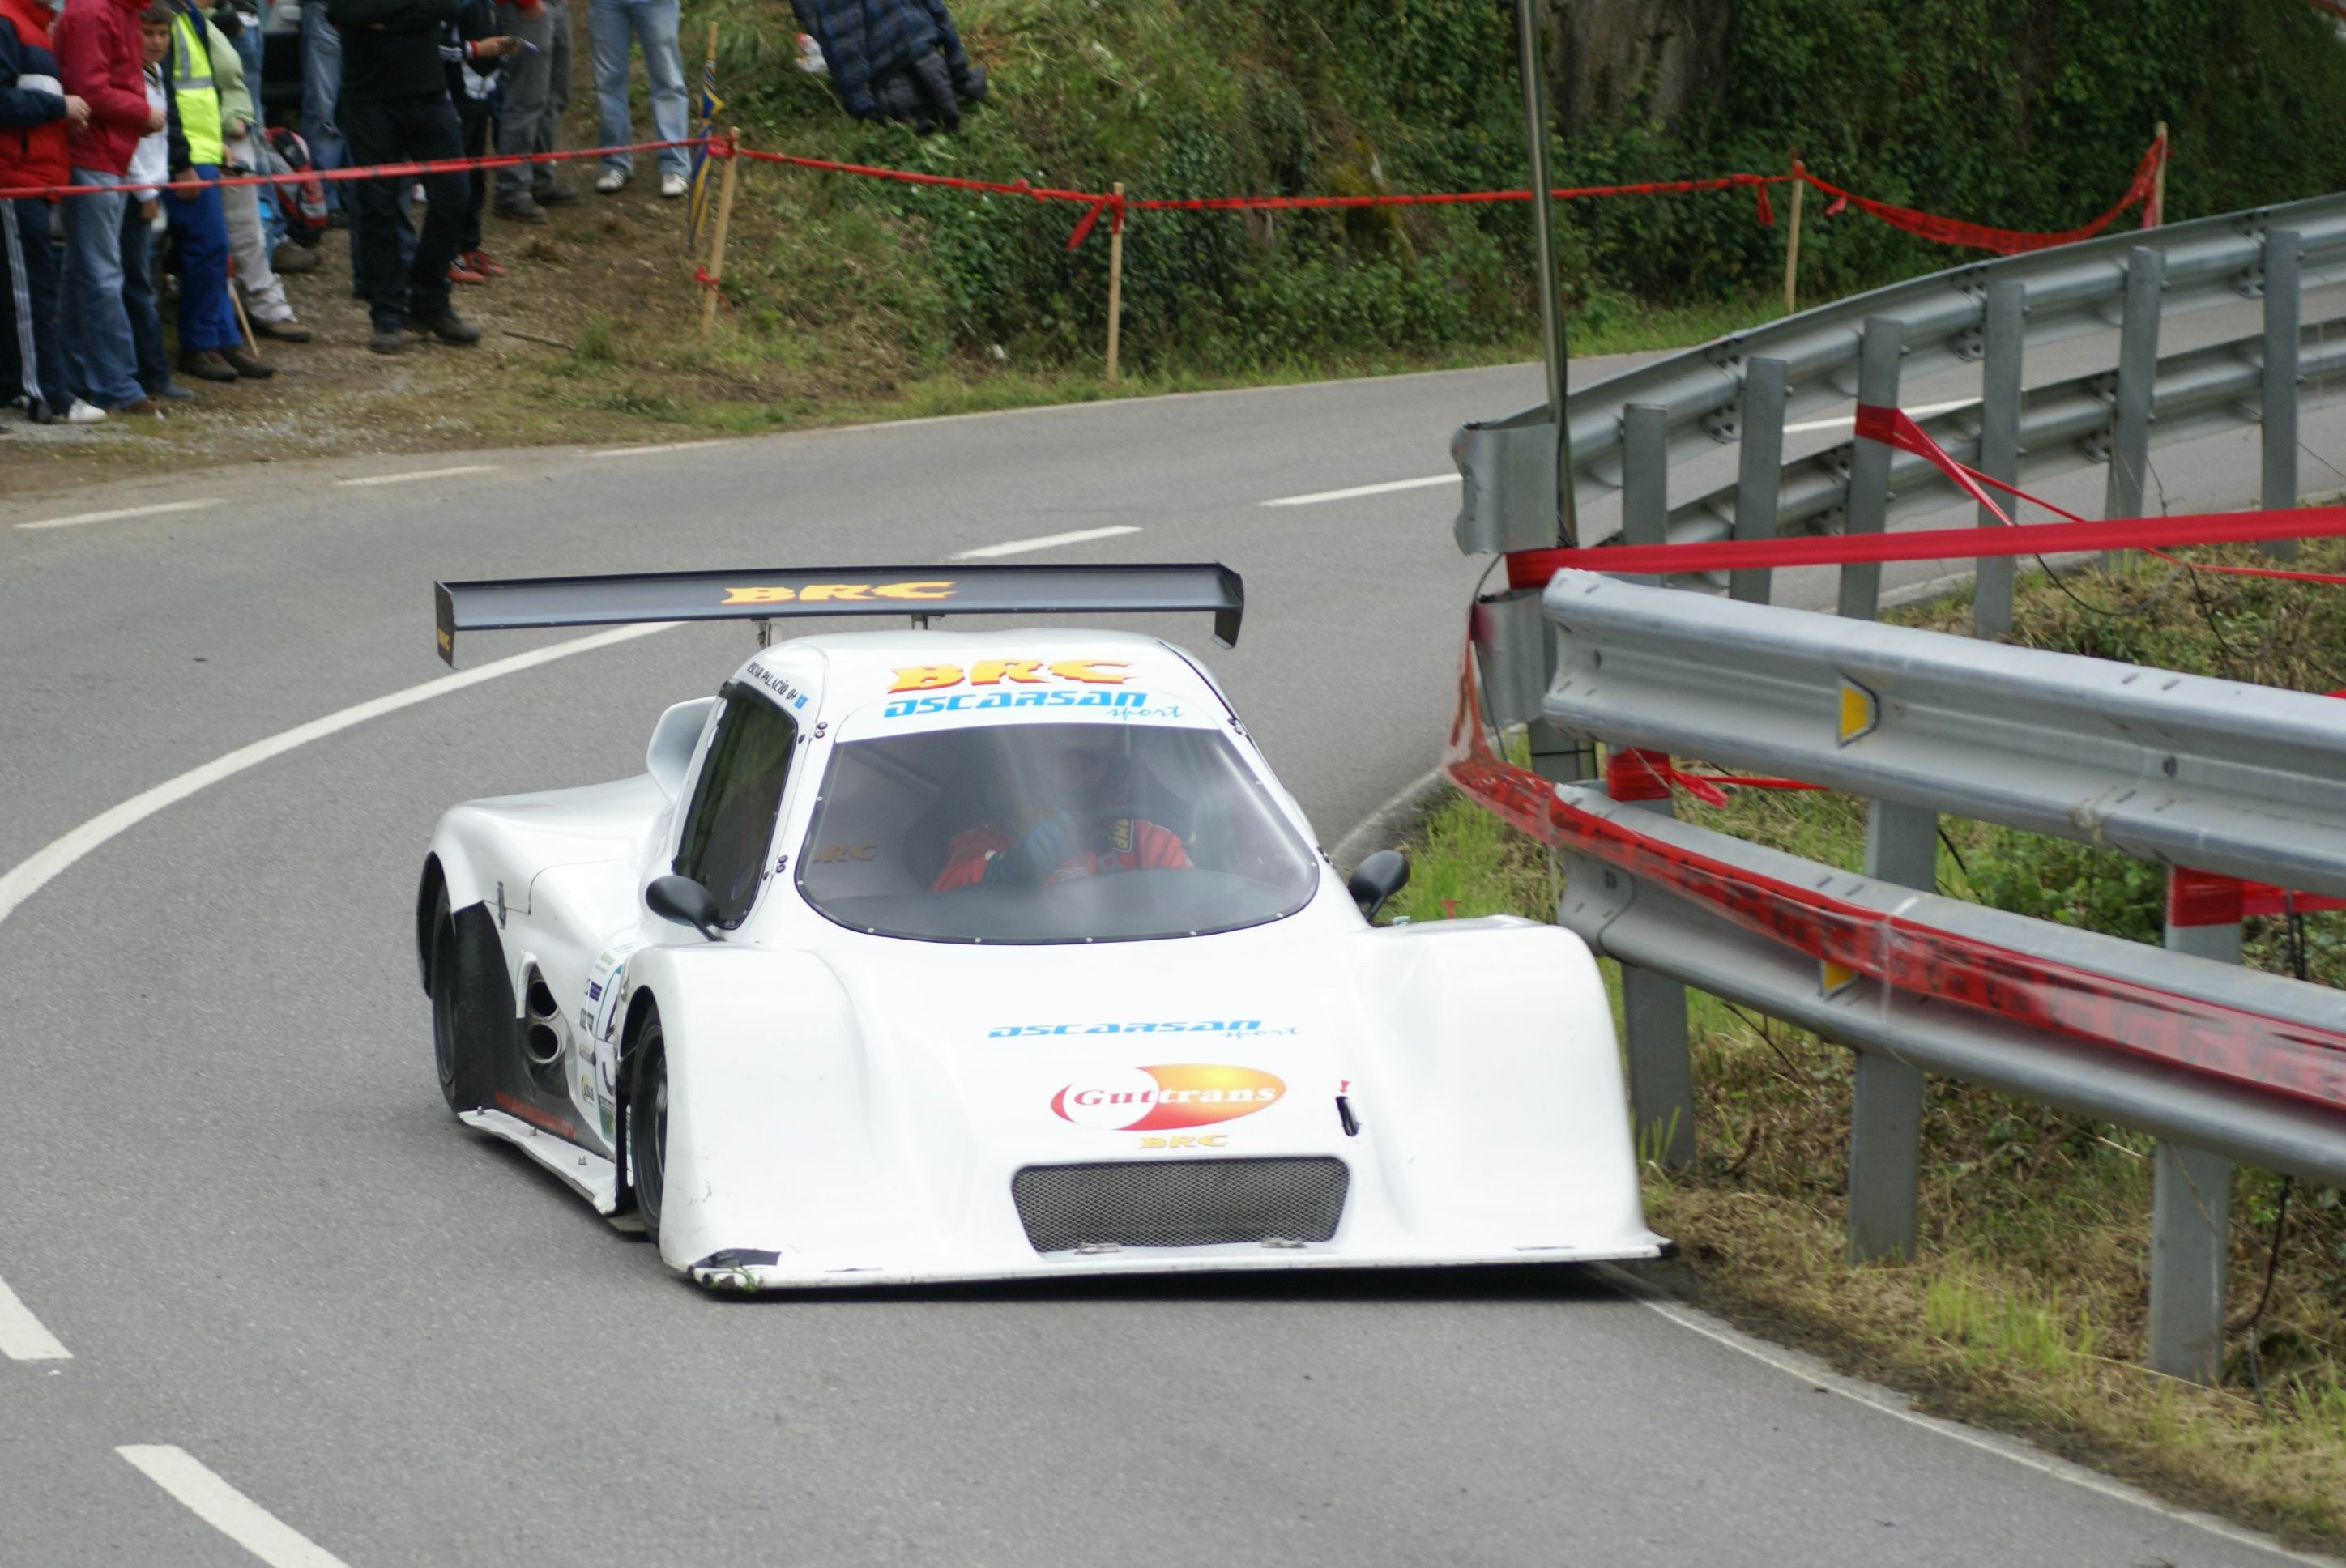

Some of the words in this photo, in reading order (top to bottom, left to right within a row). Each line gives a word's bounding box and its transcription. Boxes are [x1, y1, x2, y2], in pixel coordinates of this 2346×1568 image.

[721, 582, 958, 604] BRC
[887, 660, 1141, 694] BRC
[1106, 705, 1185, 721] sport
[1219, 1028, 1302, 1041] sport
[1074, 1086, 1276, 1106] Guttrans
[1139, 1133, 1230, 1149] BRC
